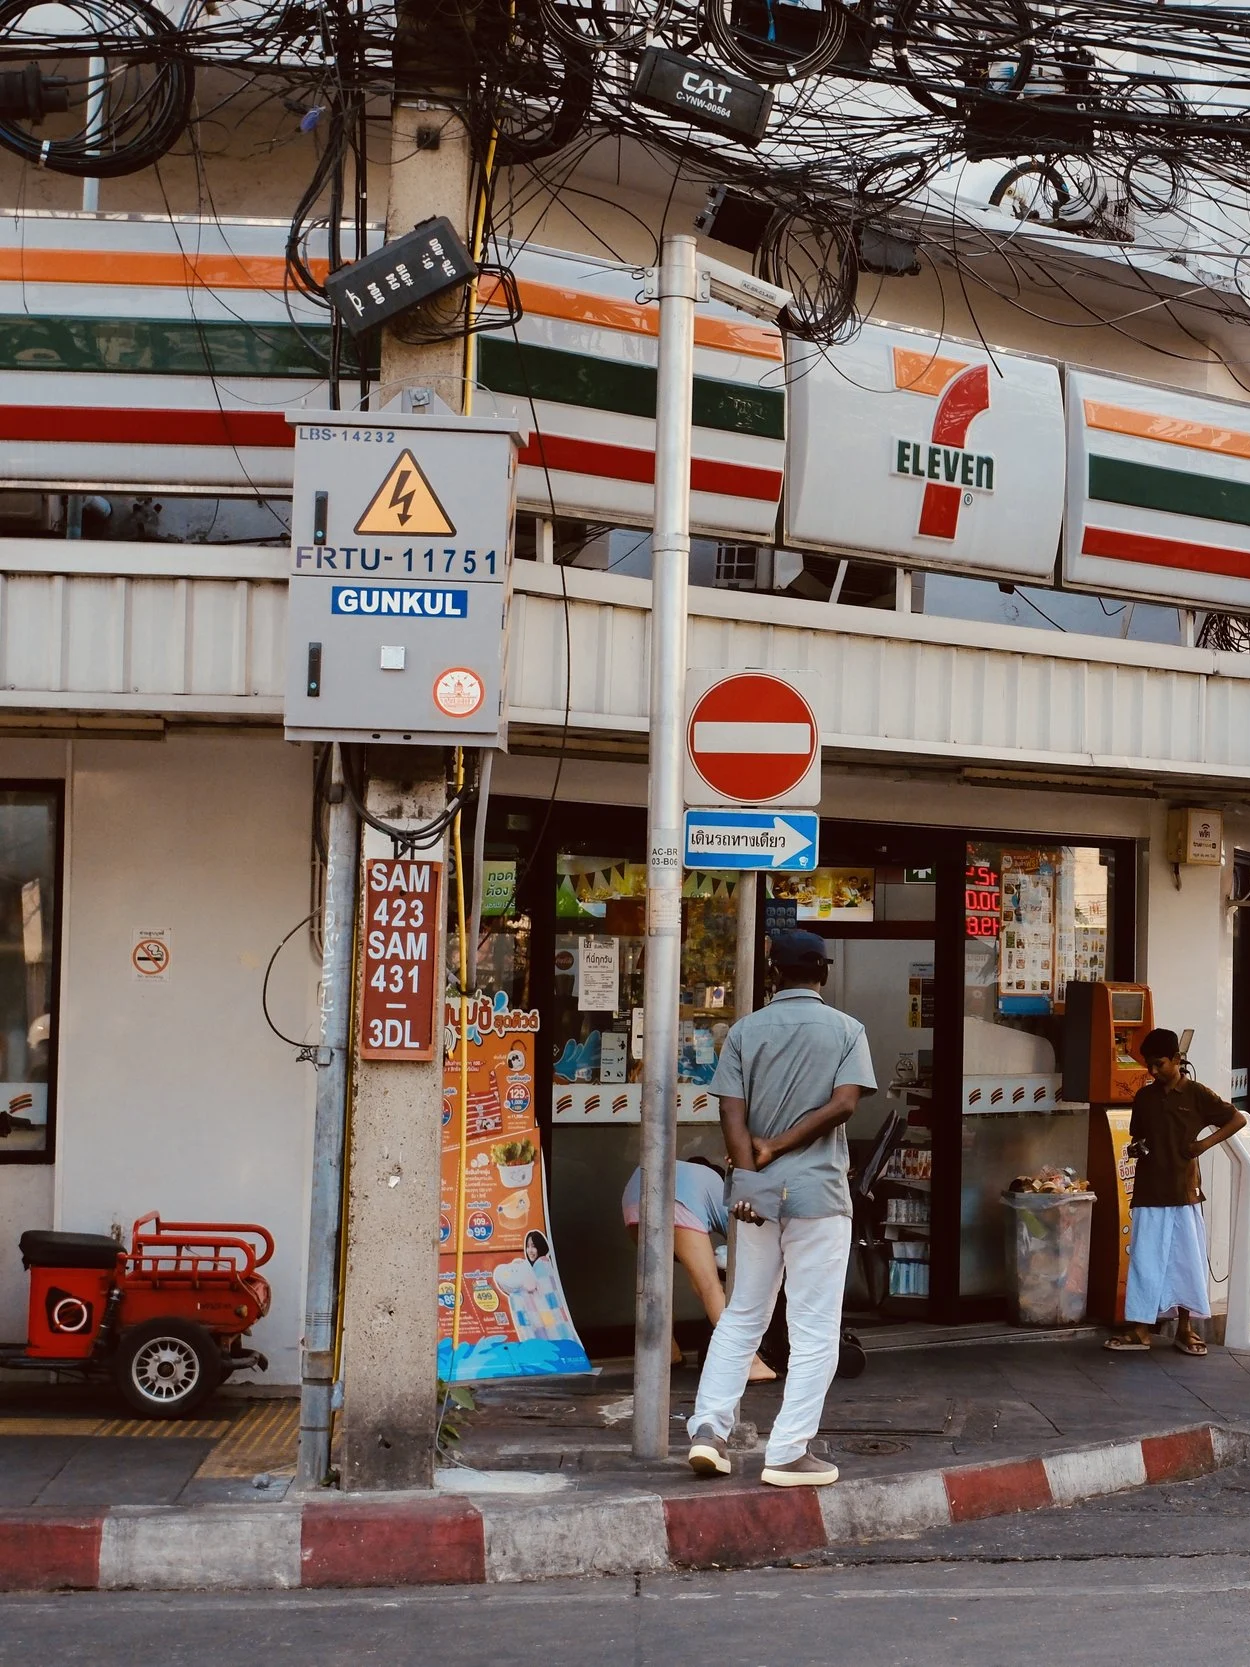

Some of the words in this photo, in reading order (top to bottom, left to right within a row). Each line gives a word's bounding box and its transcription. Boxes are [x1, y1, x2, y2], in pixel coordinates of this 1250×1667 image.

[682, 72, 732, 103] CAT
[296, 547, 497, 575] FRTU-11751
[338, 590, 461, 615] GUNKUL
[652, 848, 678, 856] AC-BR
[691, 830, 786, 848] เดินรถทางเดียว
[652, 858, 678, 866] 03-B06
[370, 863, 430, 893] SAM
[373, 898, 424, 928] 423
[368, 930, 428, 961] SAM
[370, 964, 419, 994] 431
[368, 1019, 420, 1048] 3DL
